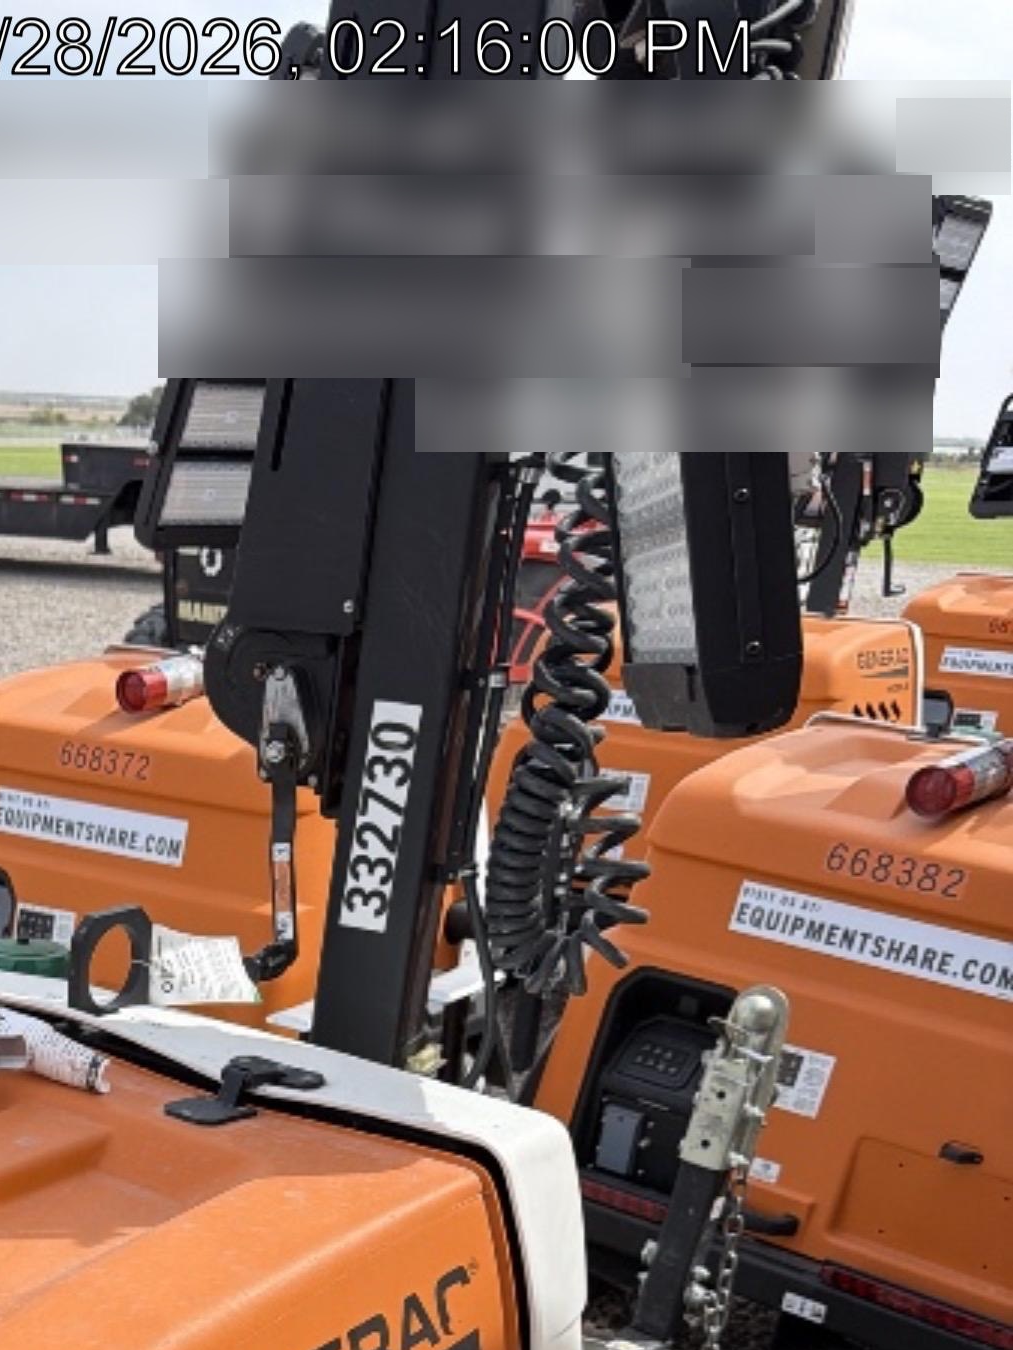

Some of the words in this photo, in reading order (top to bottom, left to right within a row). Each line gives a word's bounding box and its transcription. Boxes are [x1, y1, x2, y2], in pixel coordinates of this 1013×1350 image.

[60, 740, 150, 781] 668372
[345, 720, 418, 918] 332730
[826, 843, 966, 898] 668382
[736, 902, 1013, 992] EQUIPMENTSHARE.COM
